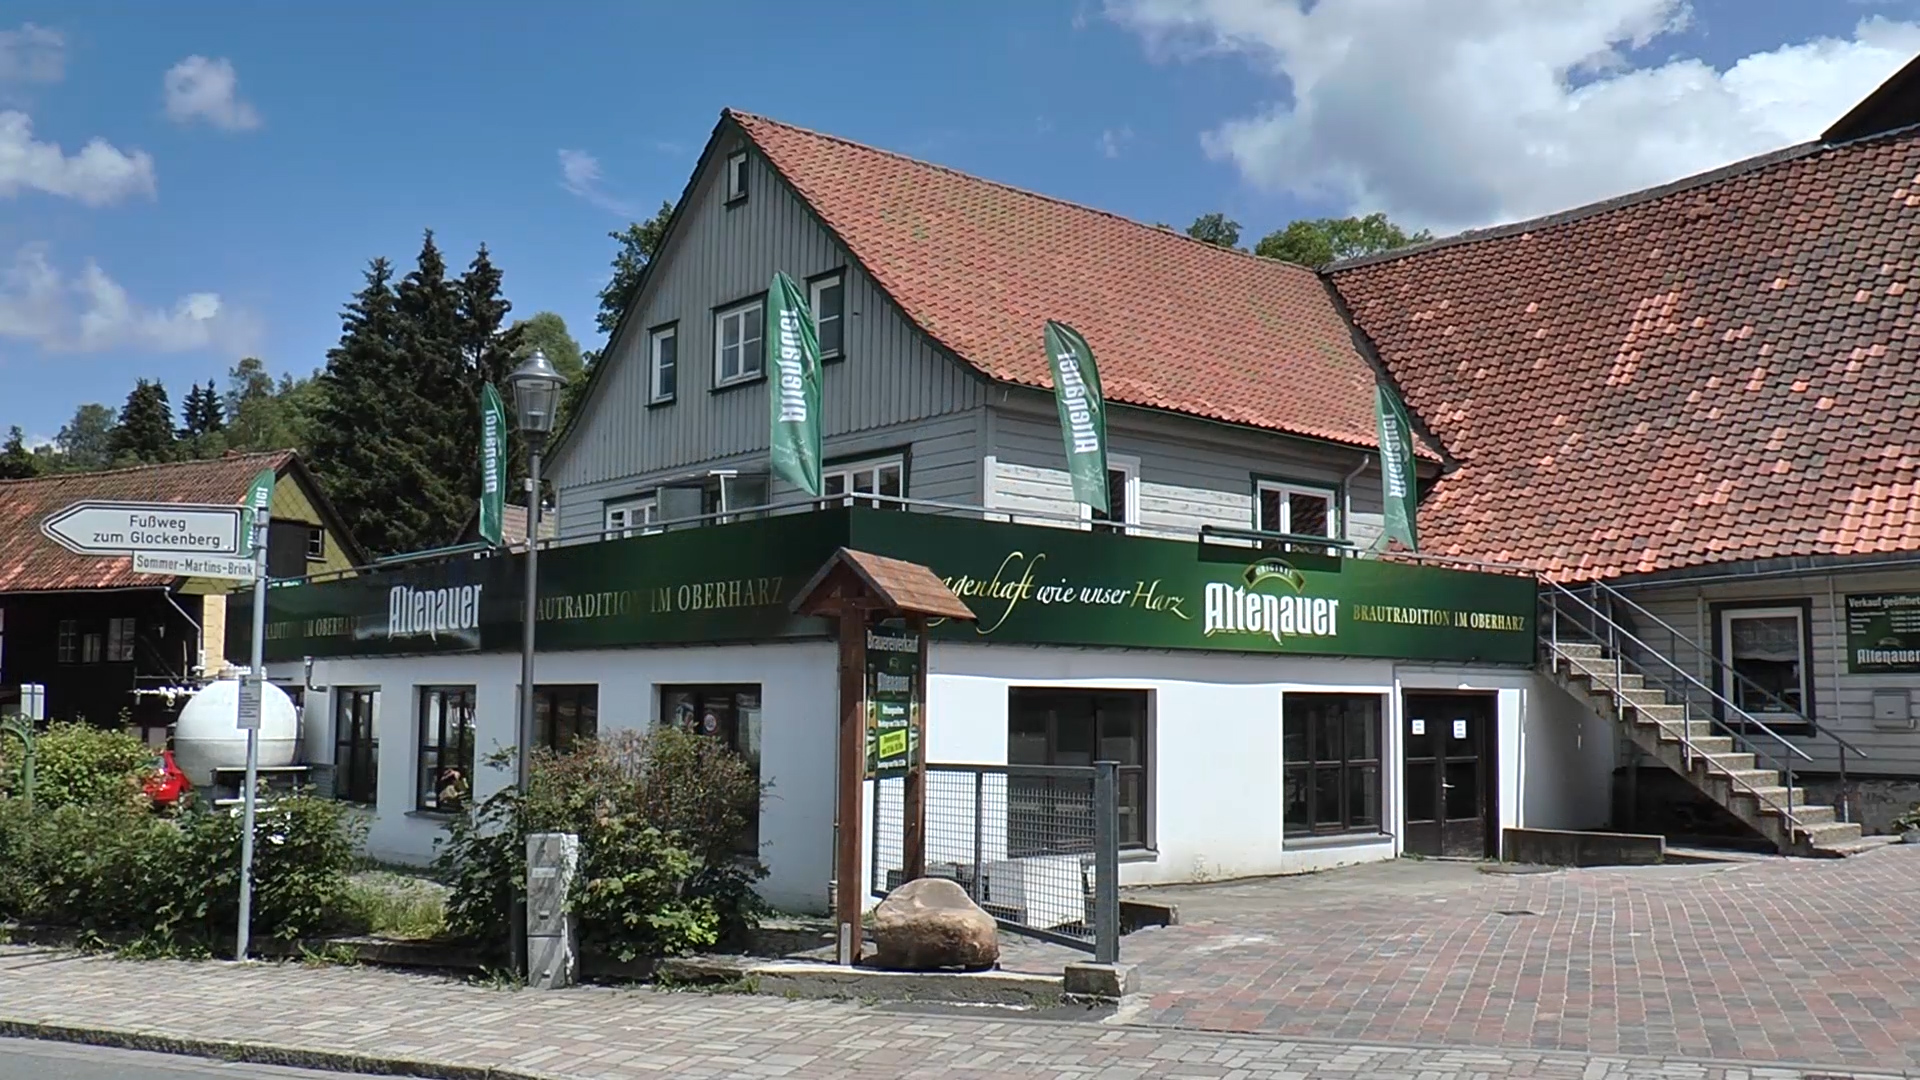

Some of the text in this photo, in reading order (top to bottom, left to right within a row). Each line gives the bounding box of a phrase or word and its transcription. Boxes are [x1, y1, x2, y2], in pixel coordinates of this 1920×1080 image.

[129, 515, 186, 532] Fußweg
[93, 531, 221, 549] zum Glockenberg
[136, 554, 253, 576] Sommer-Martins-Brink
[650, 587, 671, 612] IM
[677, 576, 783, 611] OBERHARZ
[1036, 578, 1076, 604] wie
[1080, 585, 1130, 604] unser
[1128, 579, 1194, 620] Harz
[1848, 597, 1882, 608] Verkauf
[388, 584, 483, 642] Altenauer
[1204, 582, 1339, 646] Altenauer
[1353, 604, 1525, 632] BRAUTRADITION IM OBERHARZ
[1857, 649, 1920, 665] Altenauer
